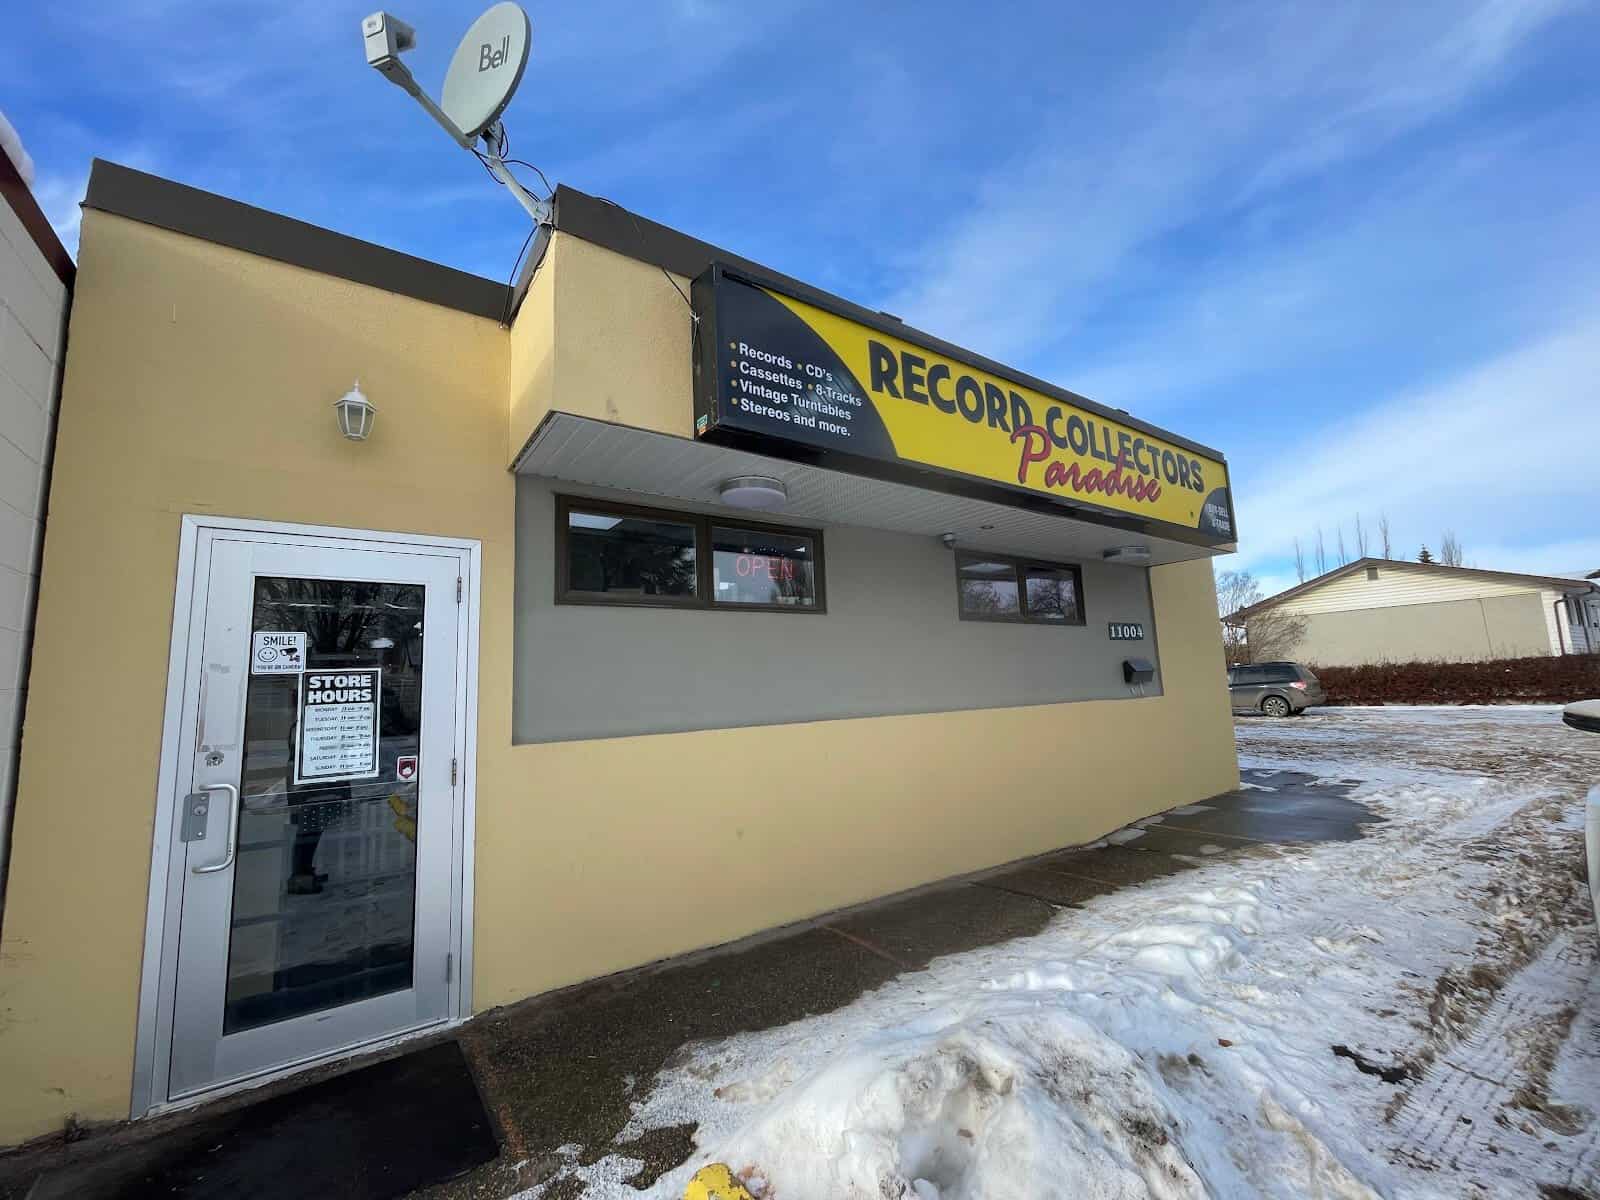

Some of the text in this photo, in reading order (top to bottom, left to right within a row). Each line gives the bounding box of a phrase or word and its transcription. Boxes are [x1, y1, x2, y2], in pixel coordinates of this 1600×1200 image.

[478, 35, 510, 72] Bell
[739, 342, 833, 383] Records CD's
[739, 361, 863, 407] Cassettes 8-Tracks
[739, 378, 852, 421] Vintage Turntables
[867, 339, 1034, 435] RECORD
[740, 397, 851, 437] Stereos and more.
[1010, 424, 1162, 503] Paradise
[1045, 405, 1205, 494] COLLECTORS
[736, 555, 793, 580] OPEN
[263, 635, 297, 646] SMILE!
[1110, 625, 1145, 638] 11004
[308, 689, 372, 703] HOURS
[309, 675, 372, 688] STORE
